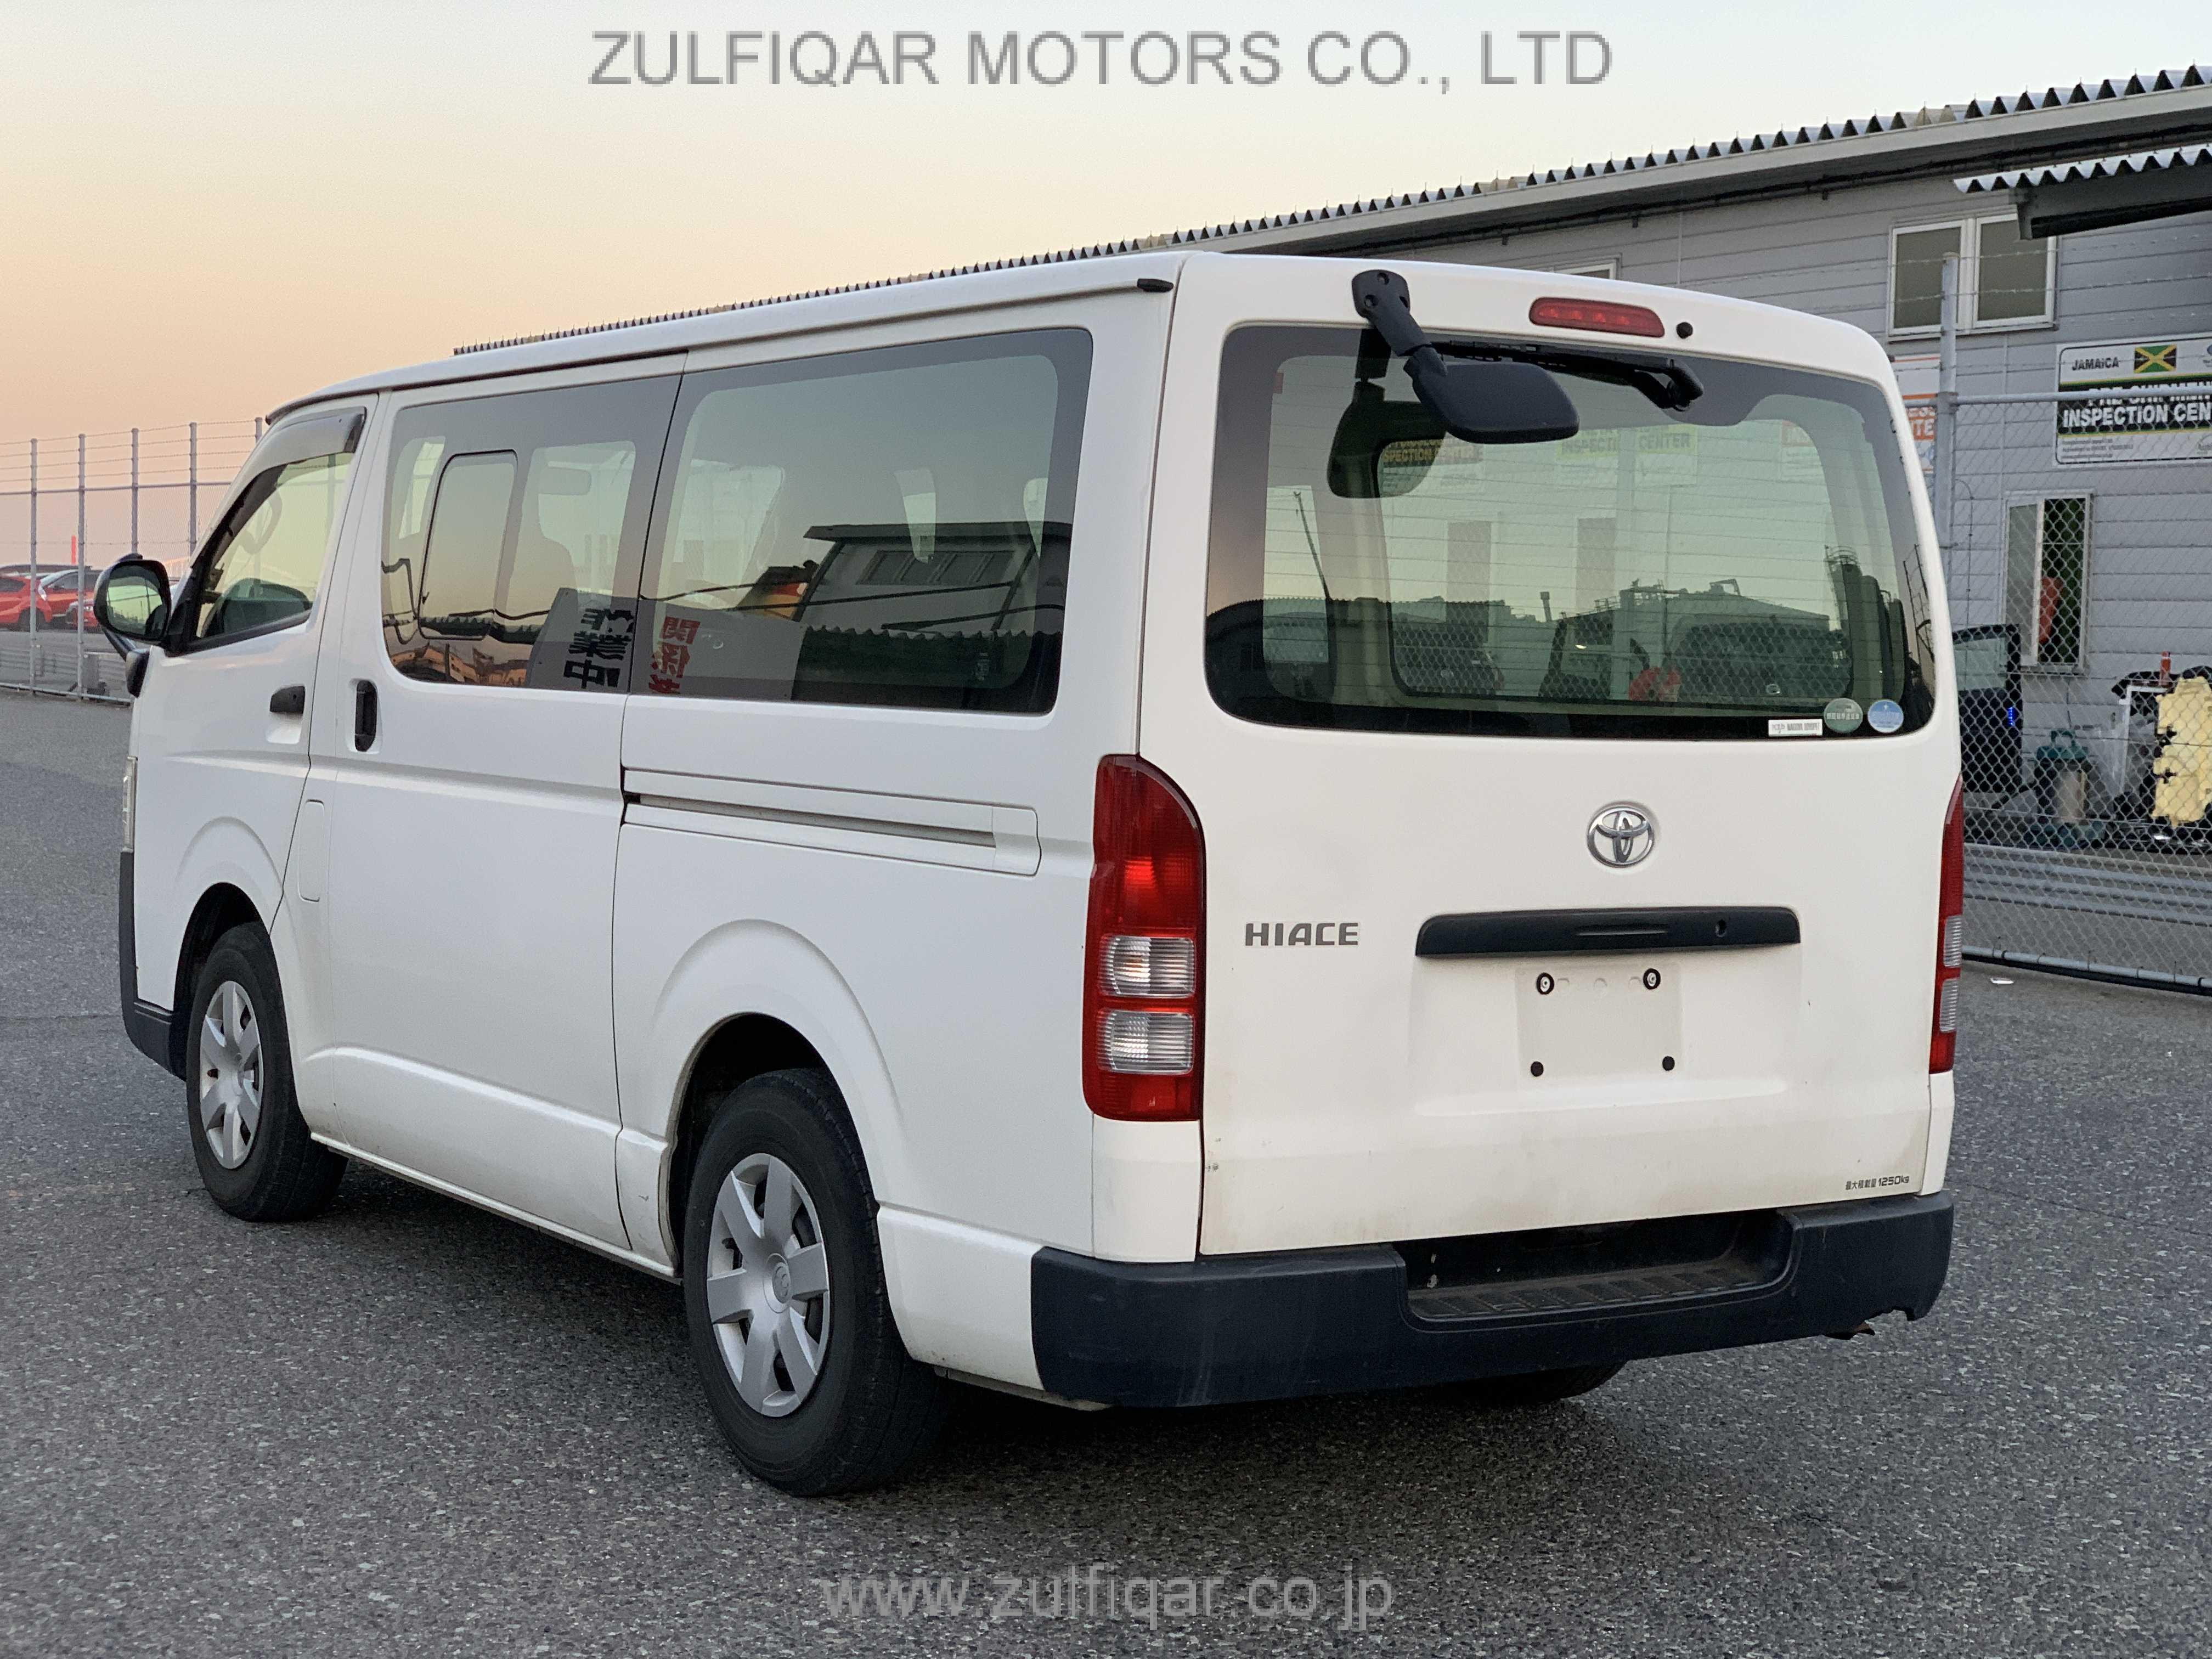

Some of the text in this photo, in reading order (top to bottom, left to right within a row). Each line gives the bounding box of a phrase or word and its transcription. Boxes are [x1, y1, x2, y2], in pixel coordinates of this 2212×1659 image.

[2072, 357, 2119, 371] JAMAICA
[2063, 404, 2169, 427] INSPECTION
[1245, 922, 1358, 946] HIACE
